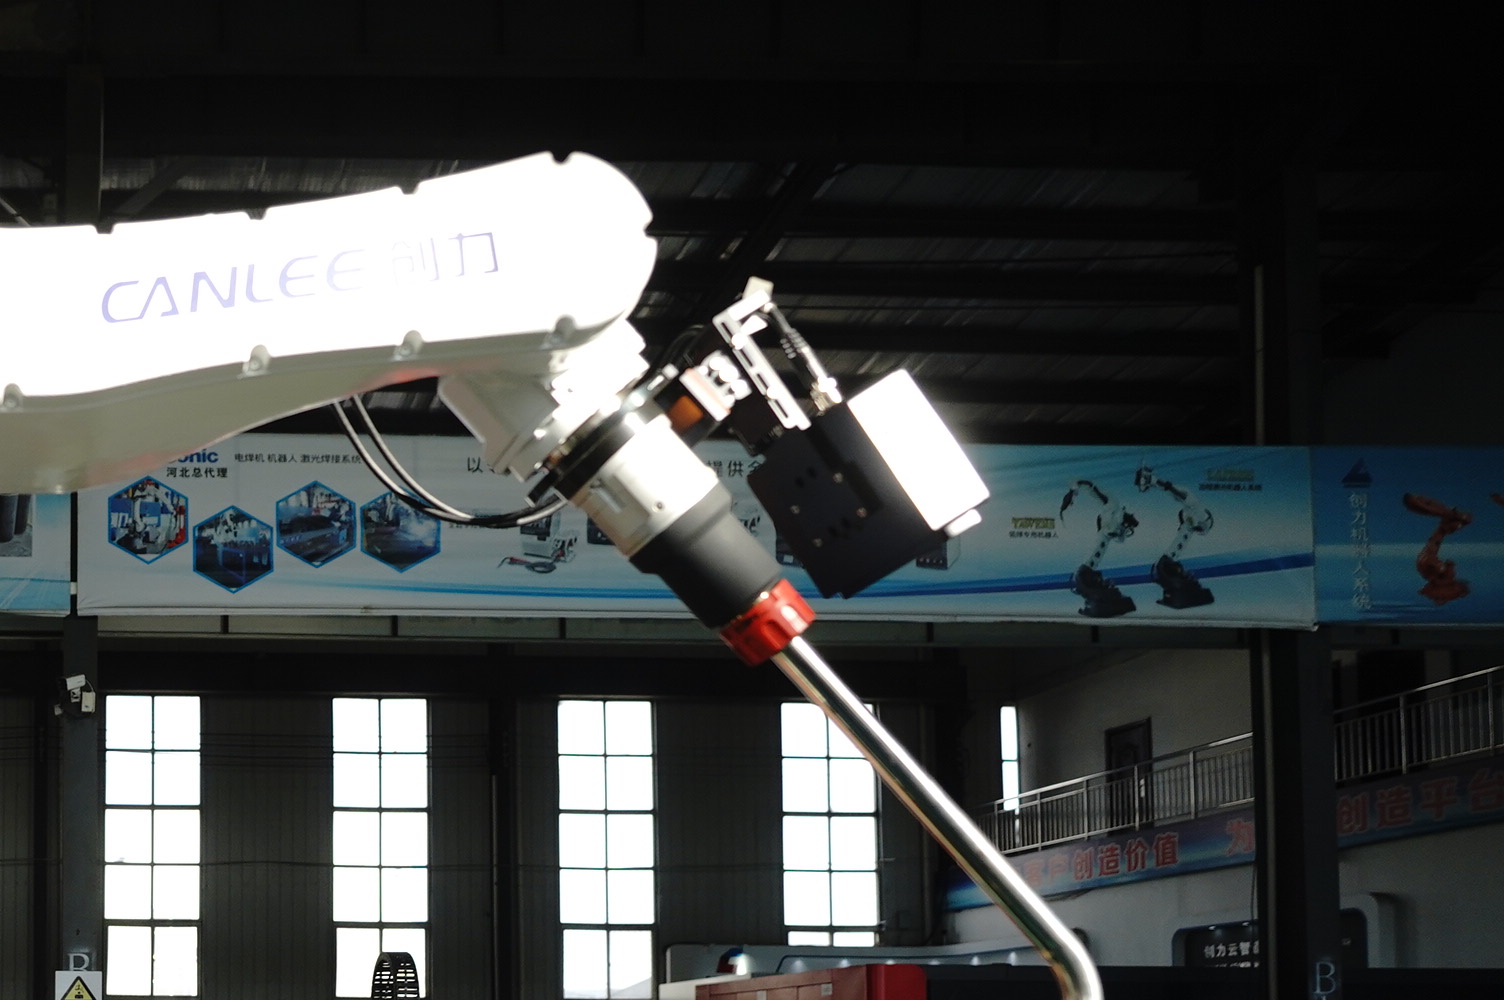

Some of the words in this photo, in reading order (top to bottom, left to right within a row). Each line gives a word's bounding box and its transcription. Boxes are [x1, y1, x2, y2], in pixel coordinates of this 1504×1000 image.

[101, 248, 365, 324] CANLEE
[166, 466, 228, 479] 河北总代理
[1336, 767, 1504, 837] 创造平台
